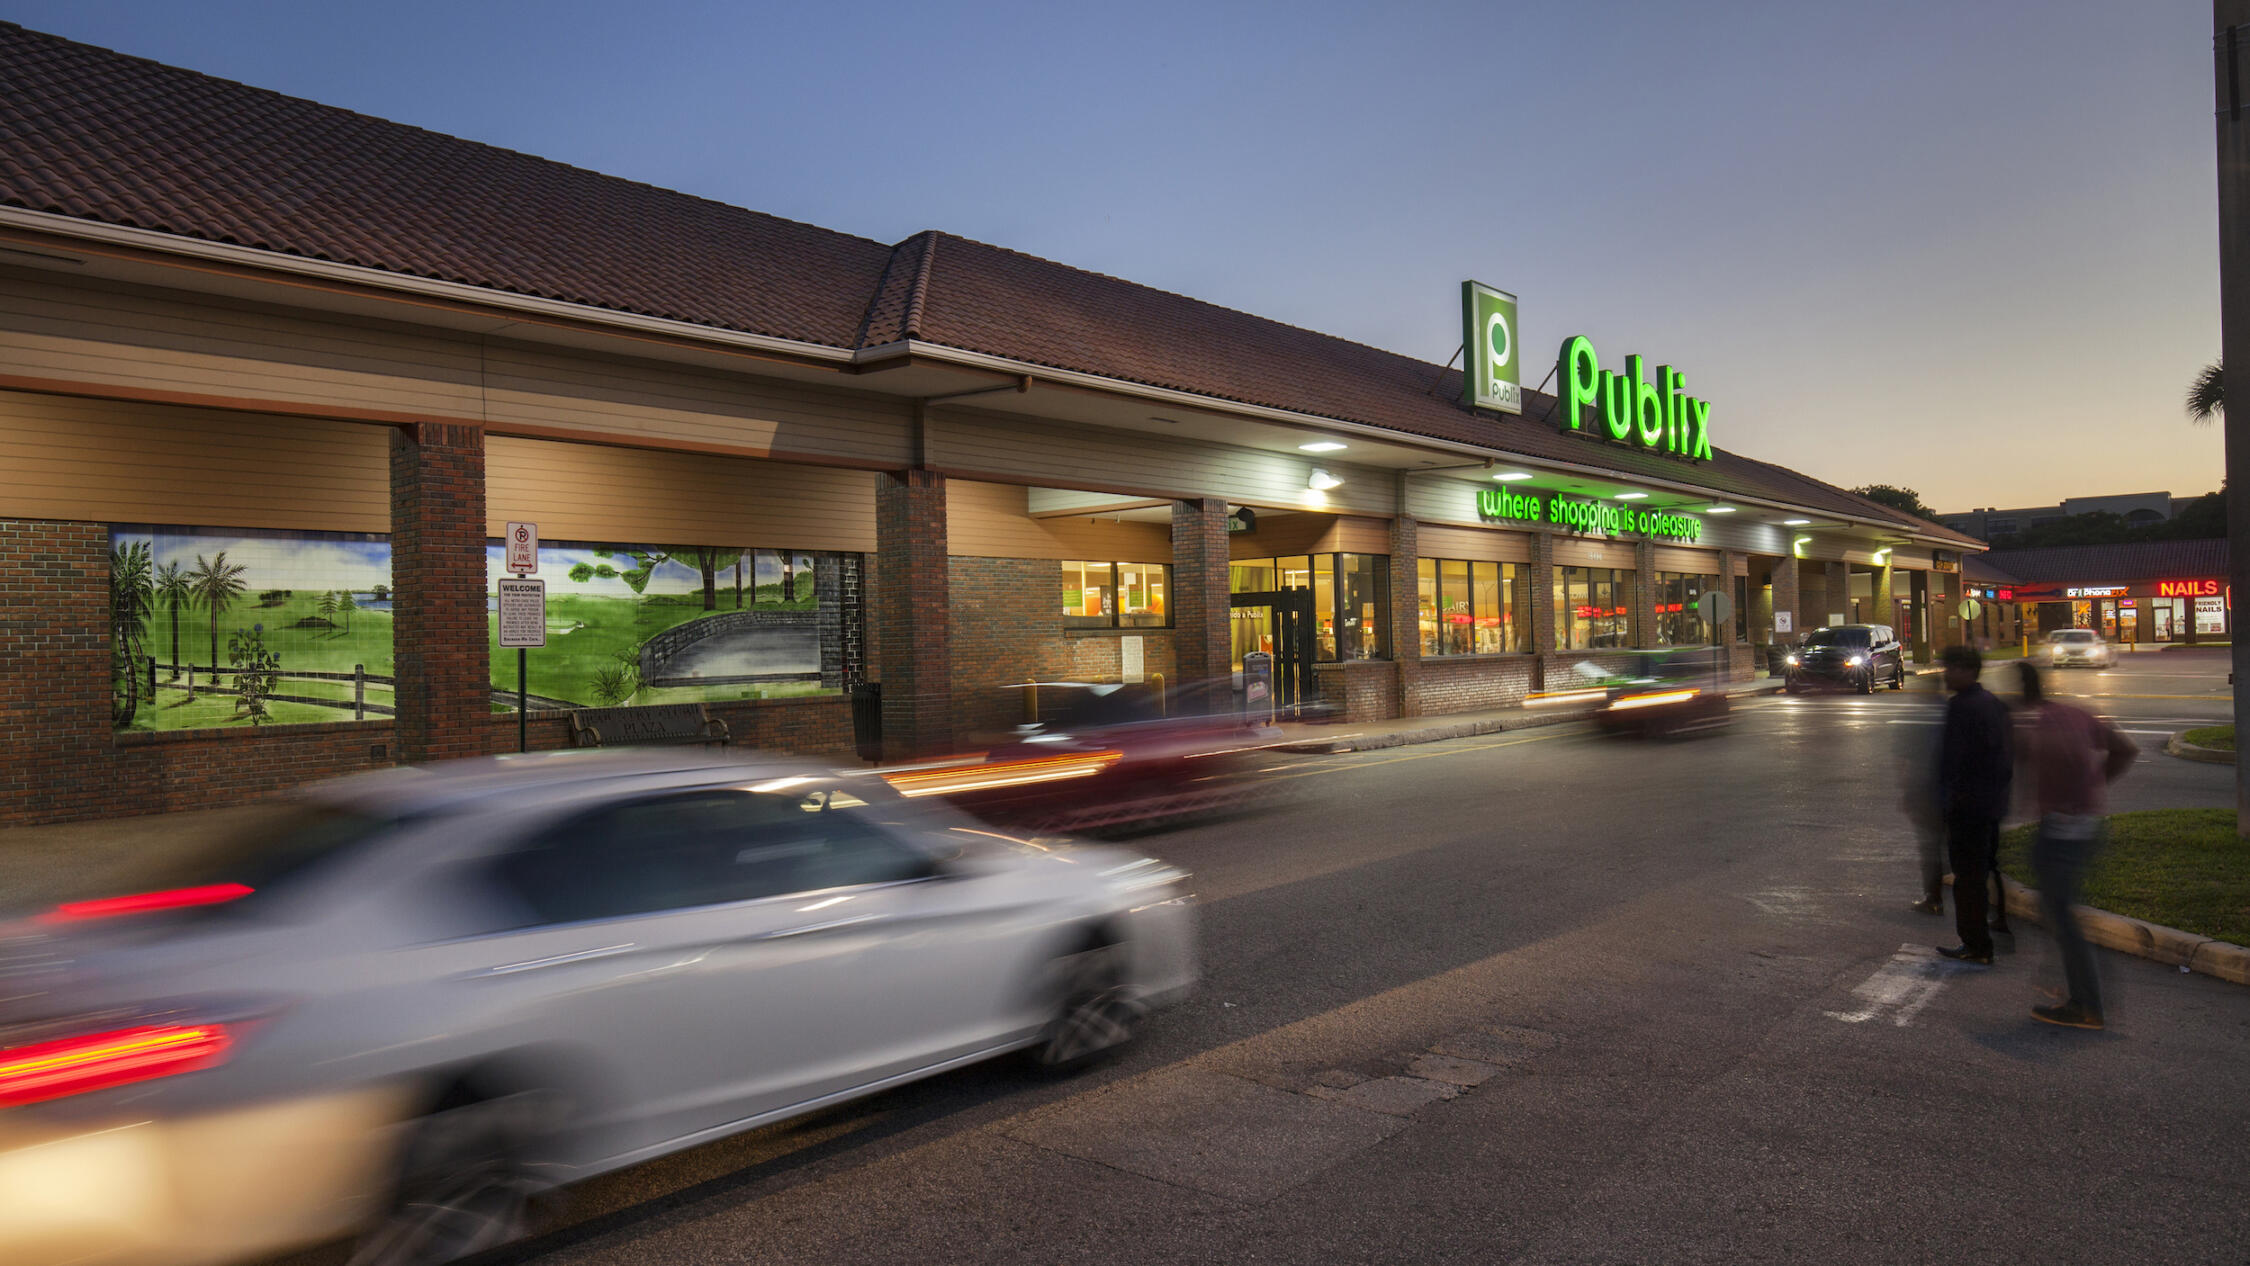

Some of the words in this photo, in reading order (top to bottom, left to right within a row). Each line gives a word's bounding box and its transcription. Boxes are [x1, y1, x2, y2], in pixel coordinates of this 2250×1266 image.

[1492, 382, 1521, 405] Publix
[1559, 335, 1712, 460] Publix
[1480, 486, 1541, 521] where
[1550, 493, 1619, 536] shopping
[1624, 503, 1635, 530] is
[1639, 509, 1648, 528] a
[1650, 507, 1702, 540] pleasure
[514, 543, 529, 552] FIRE
[513, 553, 531, 562] LANE
[502, 584, 541, 592] WELCOME
[2160, 580, 2218, 597] NAILS
